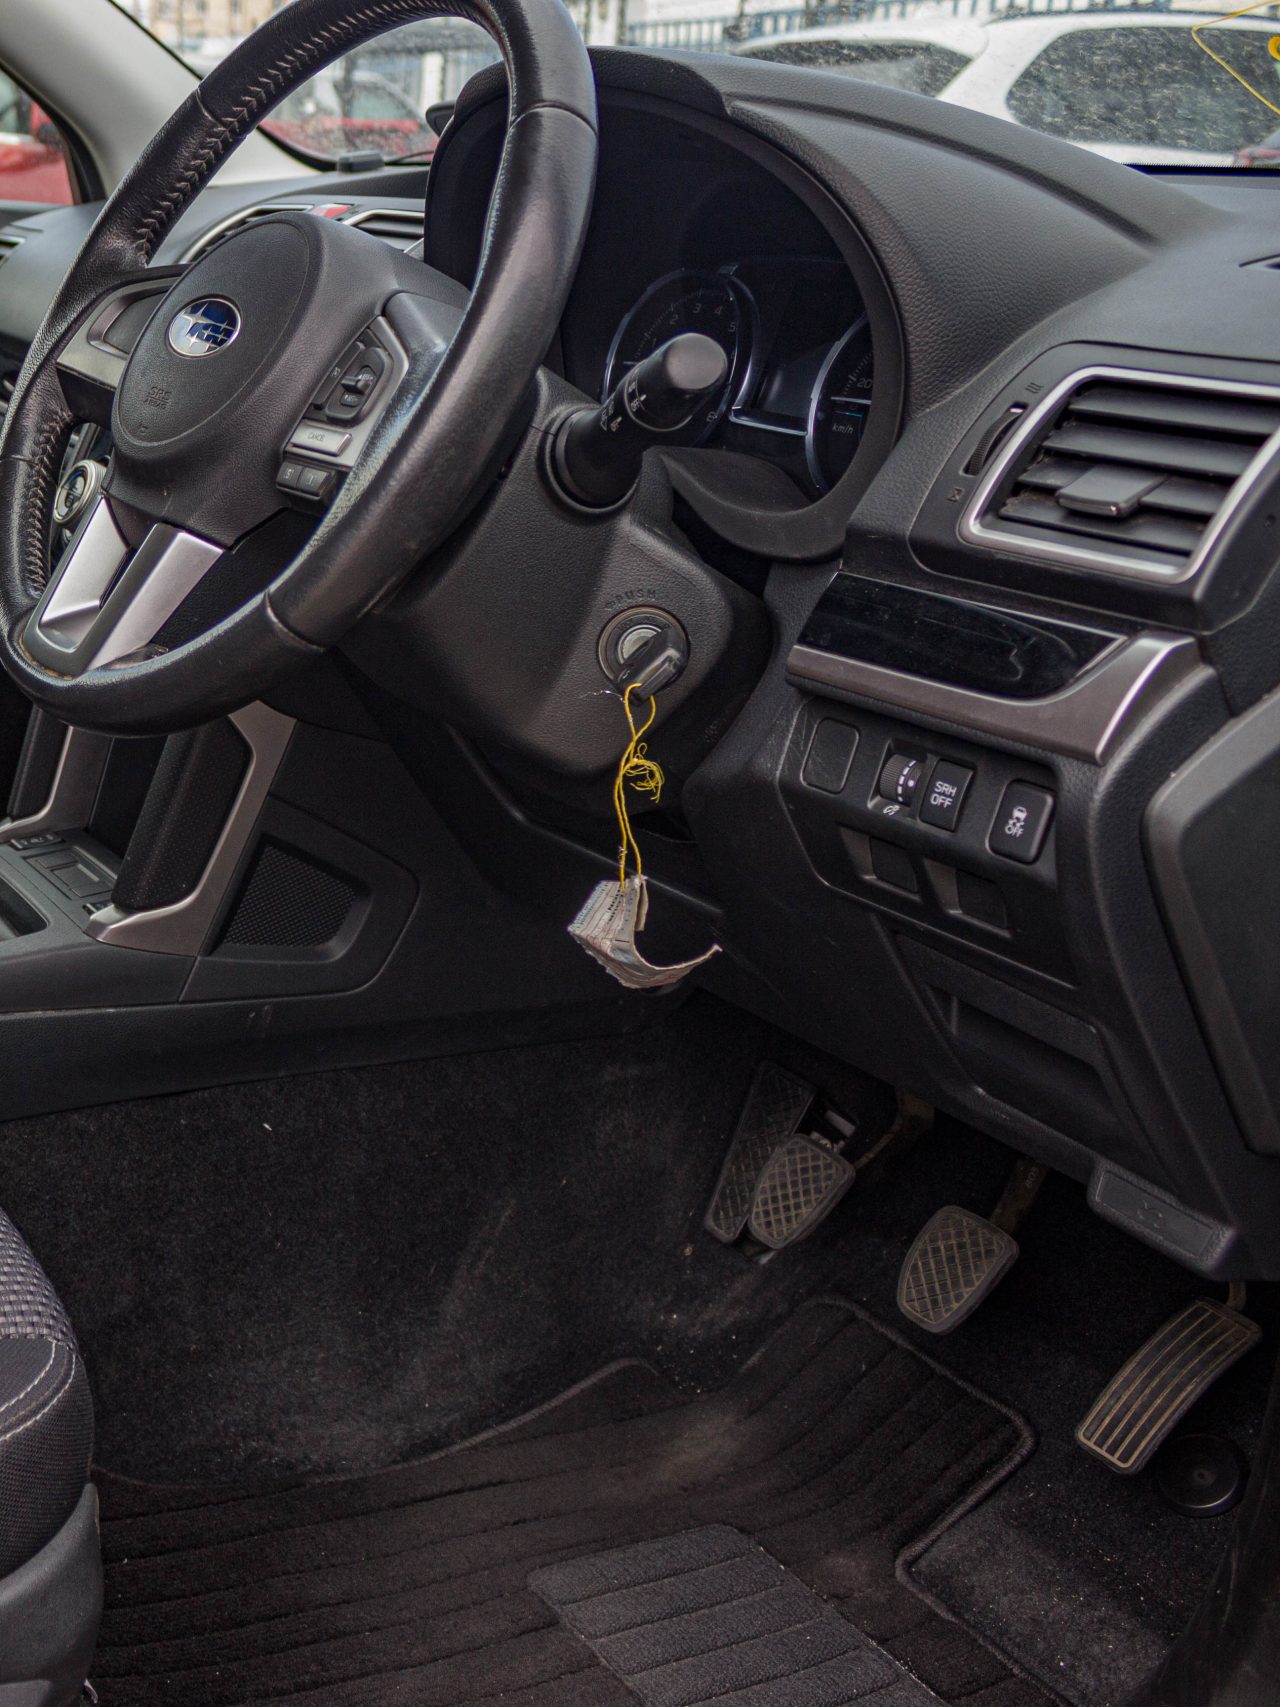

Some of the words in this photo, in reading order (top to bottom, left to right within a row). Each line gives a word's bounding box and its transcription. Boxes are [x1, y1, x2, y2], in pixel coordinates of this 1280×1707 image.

[693, 303, 701, 313] 3
[714, 305, 723, 315] 4
[670, 314, 678, 324] 2
[728, 321, 736, 333] 5
[857, 378, 872, 389] 20
[832, 423, 854, 434] km/h
[616, 588, 656, 602] PUSH
[934, 780, 958, 797] SRH
[930, 793, 953, 808] OFF
[1004, 825, 1024, 838] OFF
